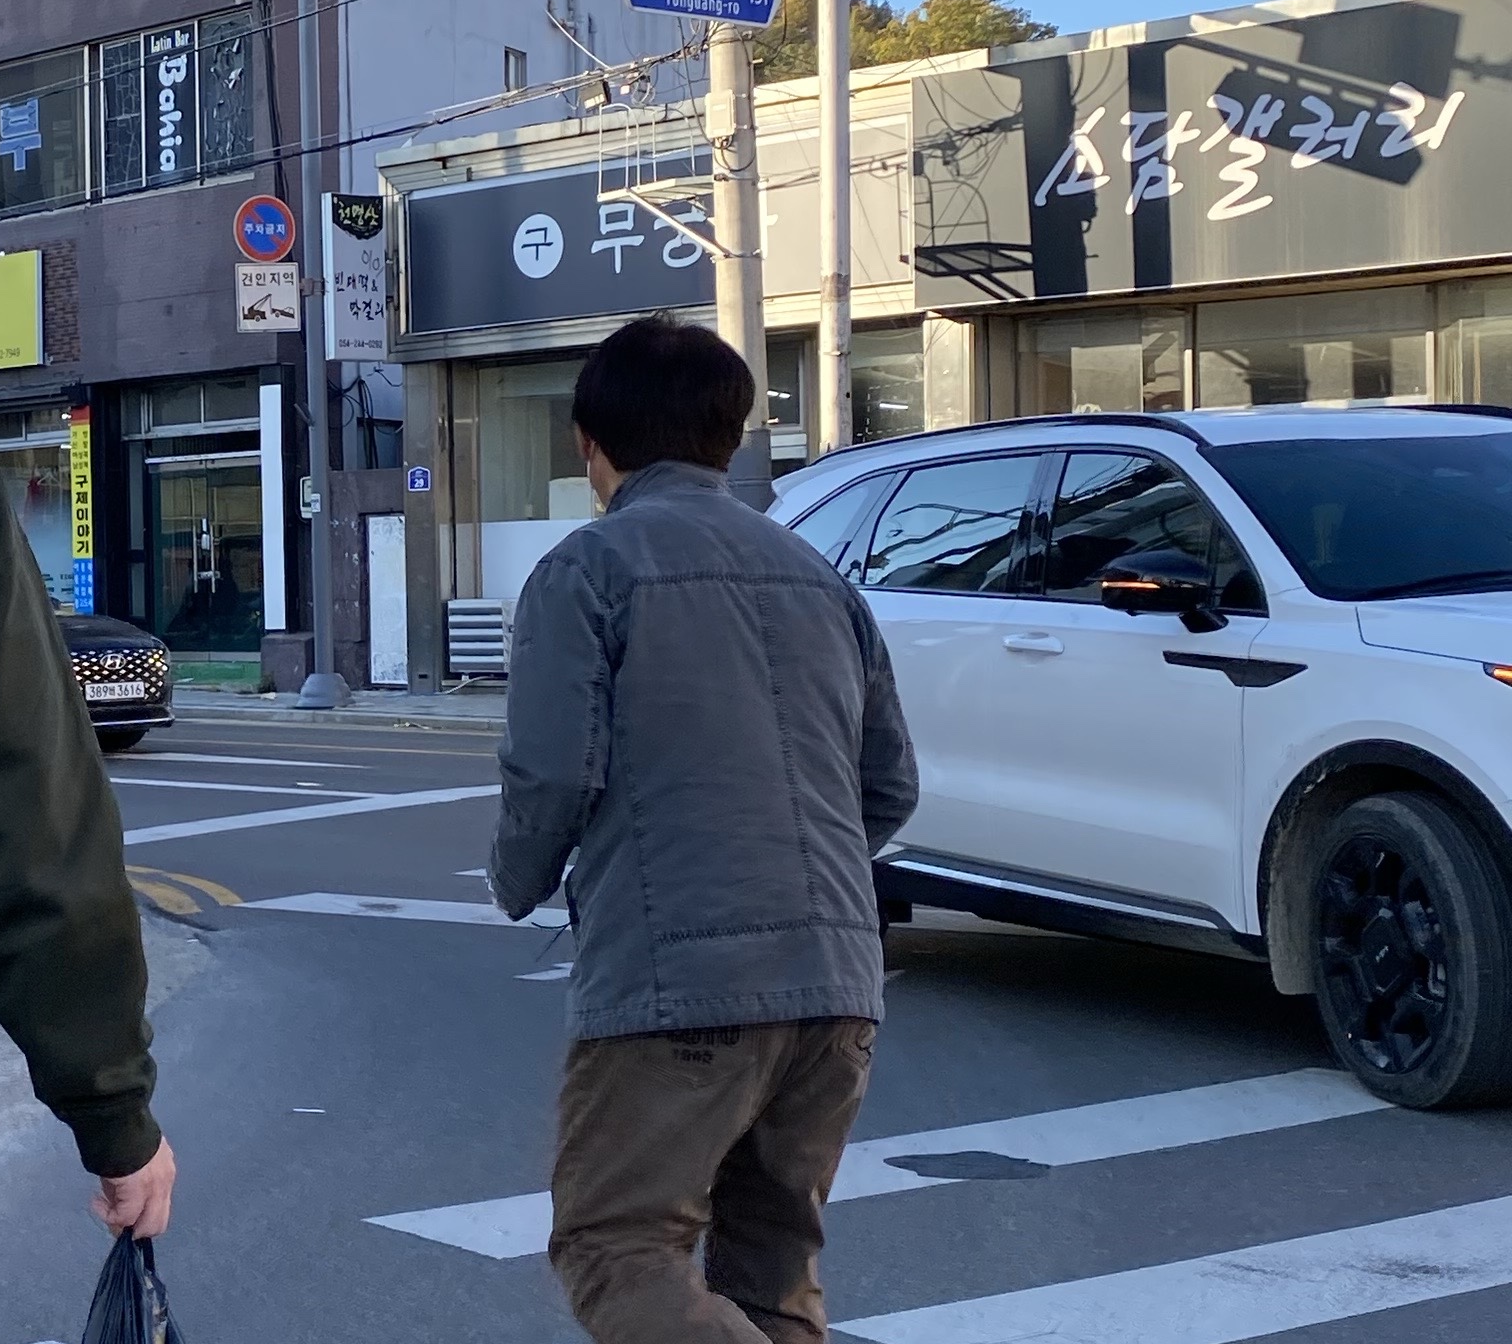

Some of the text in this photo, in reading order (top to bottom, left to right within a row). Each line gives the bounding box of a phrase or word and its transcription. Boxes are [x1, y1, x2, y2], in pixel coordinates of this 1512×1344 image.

[157, 54, 187, 173] Bahia
[1034, 81, 1467, 222] 소담갤러리
[243, 221, 287, 239] 주차금지
[521, 201, 778, 273] 구 무궁
[240, 270, 296, 288] 견인지역
[75, 474, 90, 554] 구제이야기
